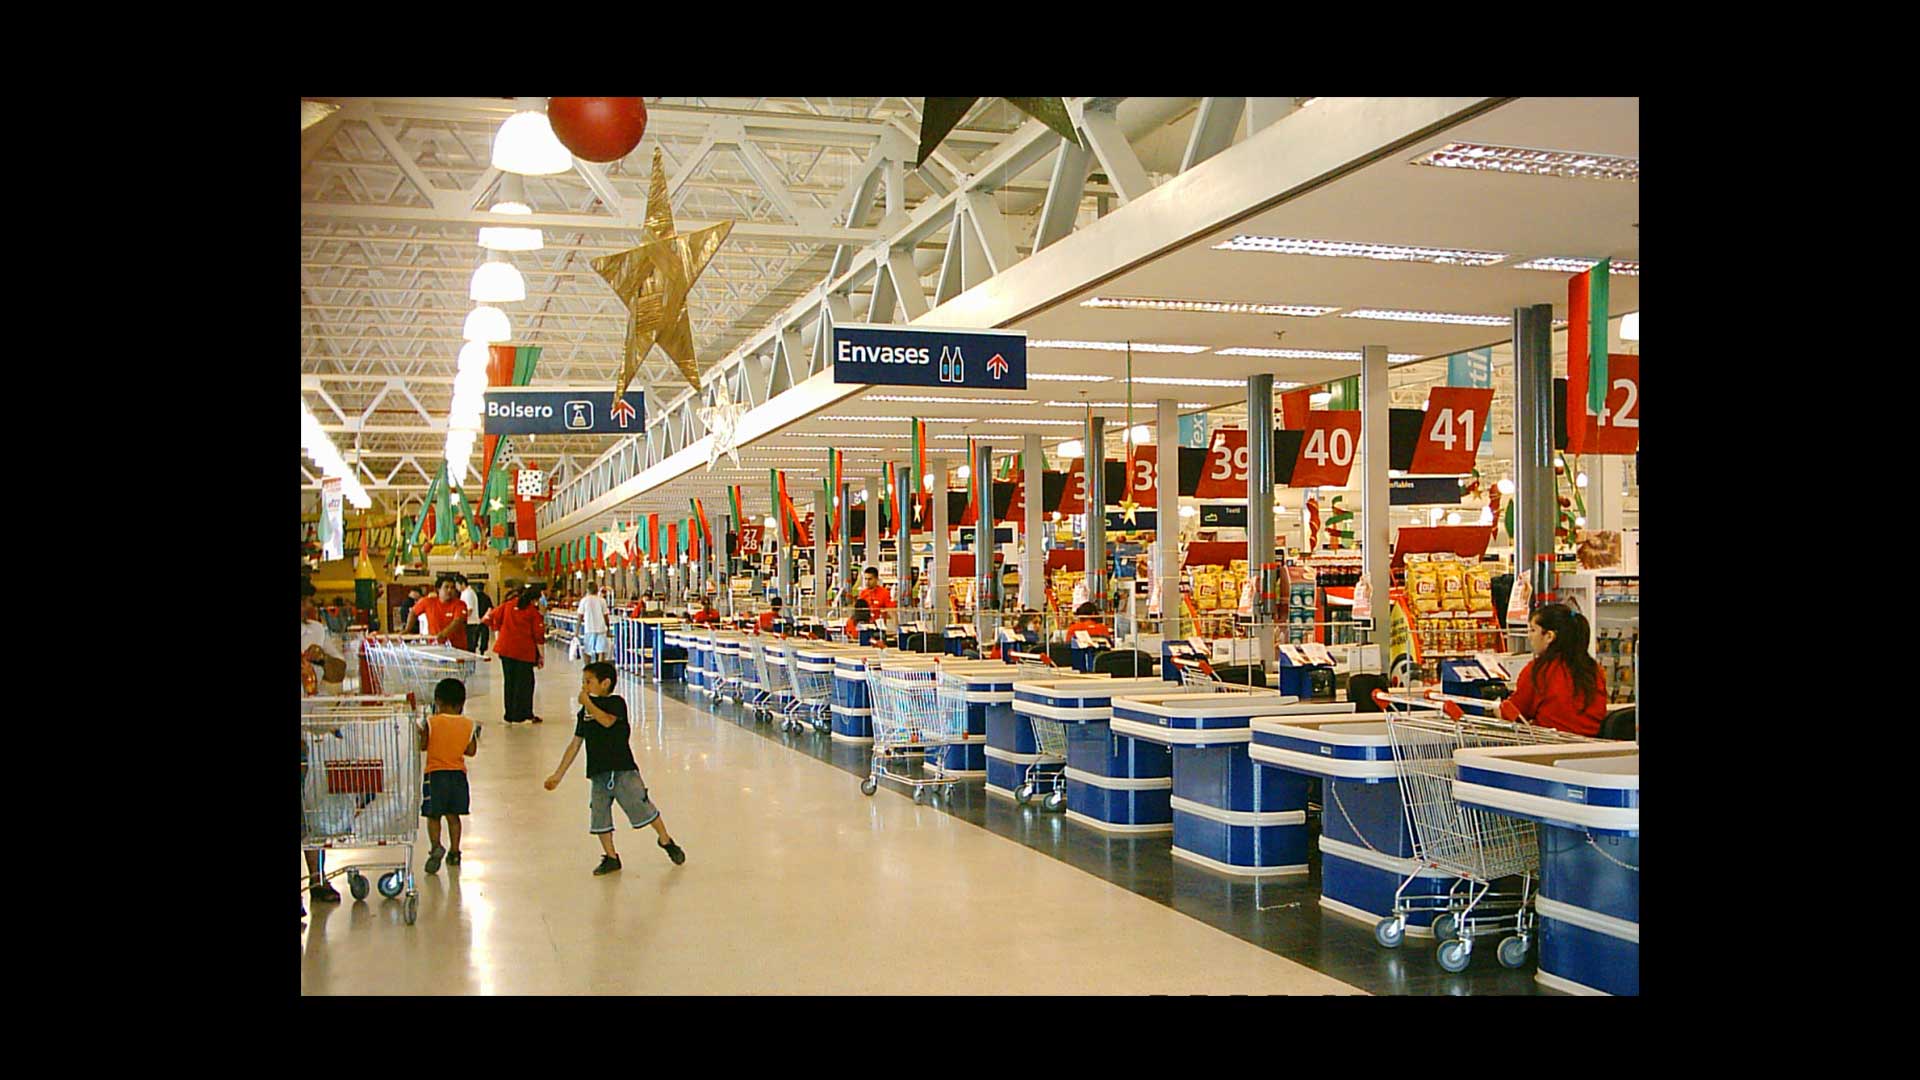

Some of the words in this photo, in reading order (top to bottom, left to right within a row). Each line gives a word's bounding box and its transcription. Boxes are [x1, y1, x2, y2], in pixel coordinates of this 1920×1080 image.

[838, 340, 930, 364] Envases
[1467, 352, 1488, 388] til
[488, 401, 553, 418] Bolsero
[1190, 413, 1204, 448] Tex
[1428, 408, 1475, 452] 41
[1211, 446, 1248, 480] 39
[1303, 428, 1353, 467] 40
[743, 529, 758, 540] 27
[743, 540, 758, 551] 28
